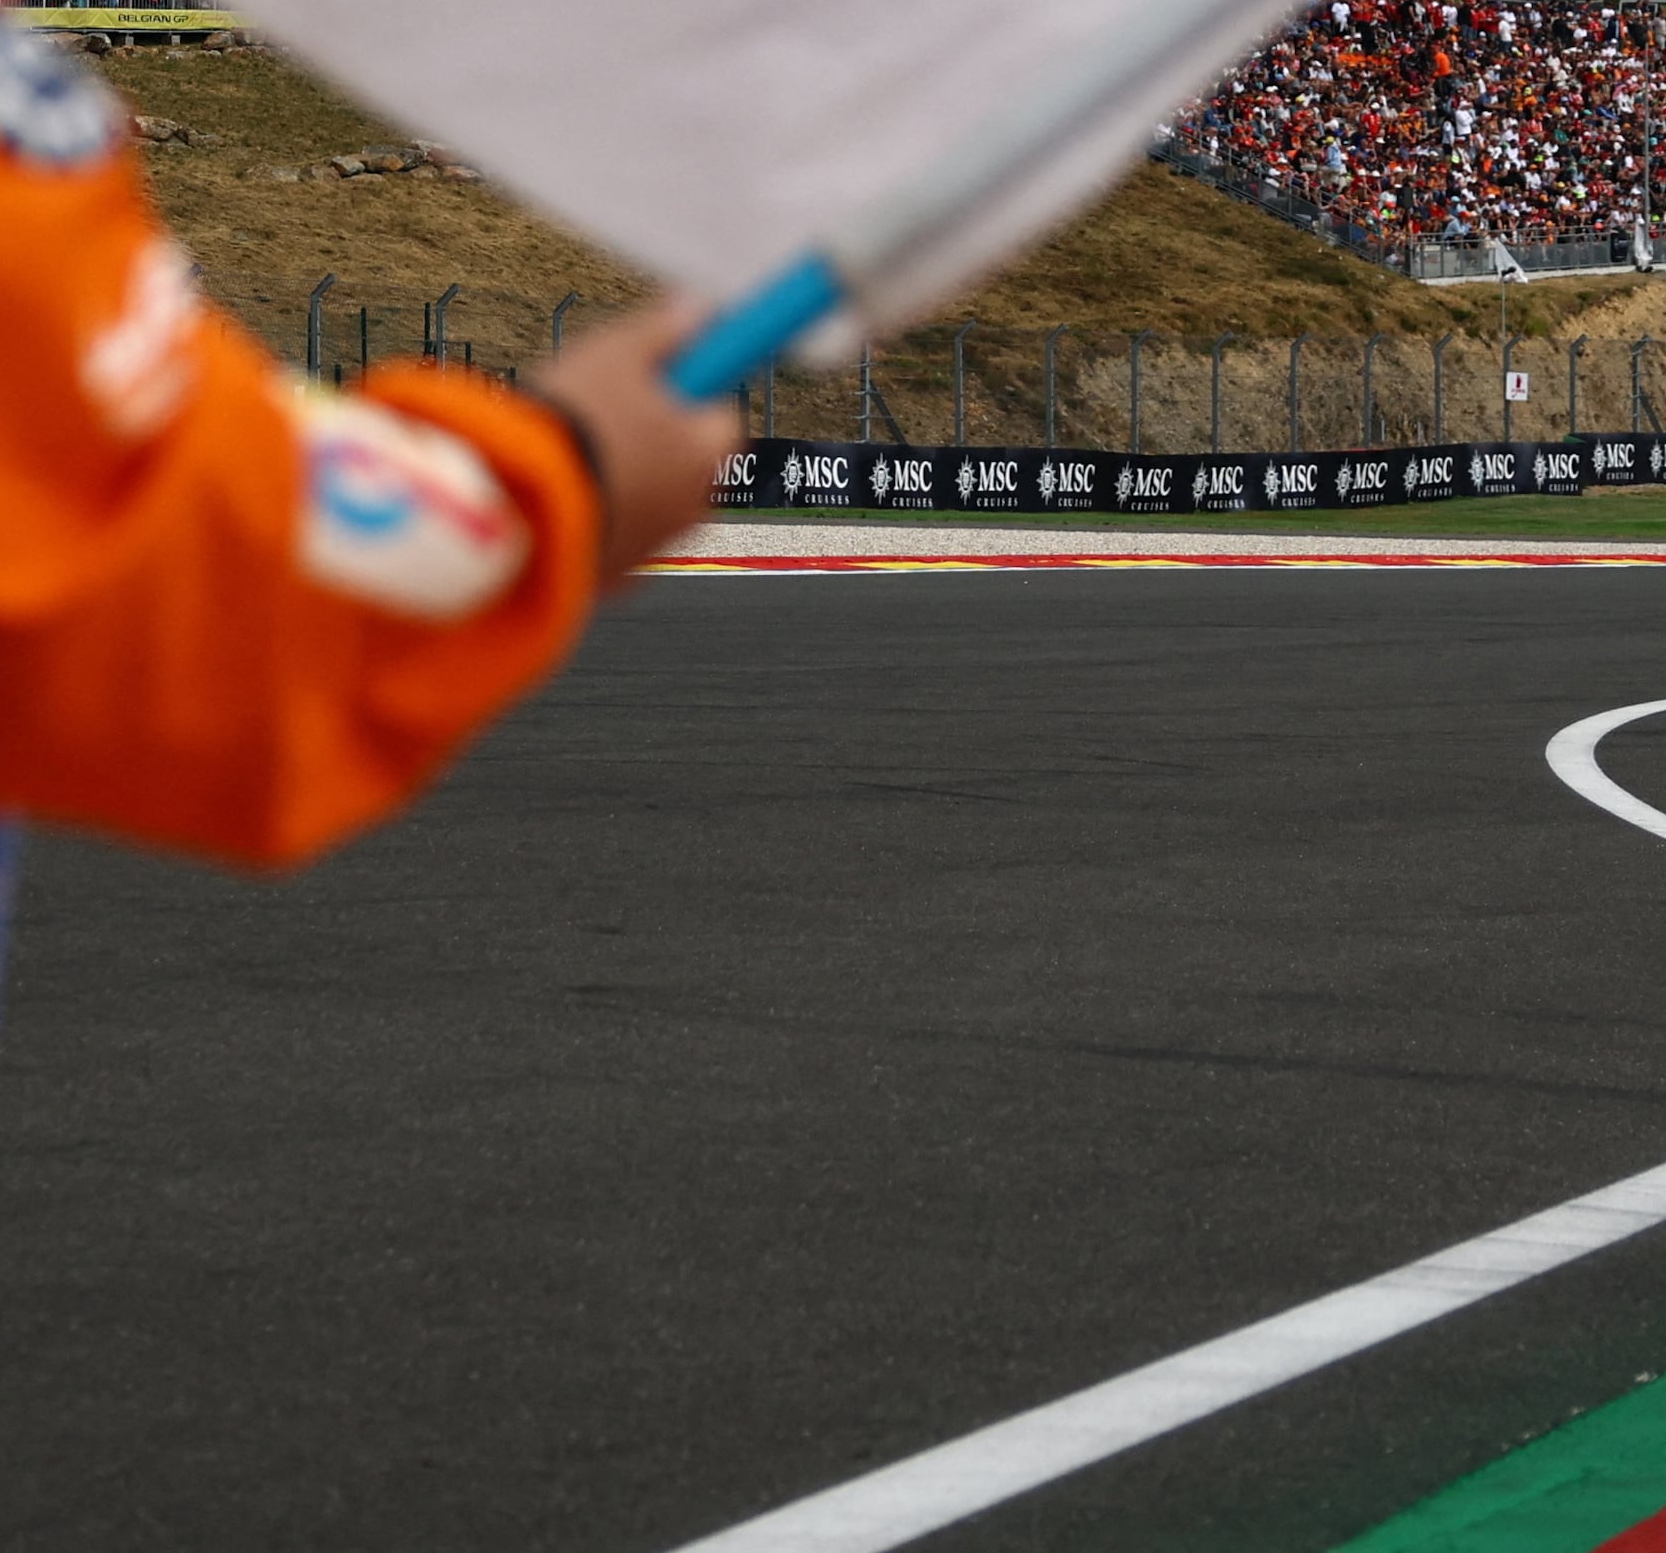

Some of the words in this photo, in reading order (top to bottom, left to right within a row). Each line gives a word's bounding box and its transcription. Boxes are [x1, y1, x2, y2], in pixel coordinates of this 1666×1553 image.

[118, 13, 171, 23] BELGIAN
[173, 14, 189, 23] GP
[1607, 444, 1635, 468] MSC
[712, 453, 757, 485] MSC
[804, 455, 849, 488] MSC
[893, 460, 933, 492] MSC
[1353, 462, 1388, 489] MSC
[1421, 457, 1453, 483] MSC
[1484, 454, 1515, 480] MSC
[1548, 454, 1580, 480] MSC
[978, 462, 1018, 491] MSC
[1058, 463, 1095, 493] MSC
[1133, 468, 1172, 496] MSC
[1209, 466, 1243, 495] MSC
[1281, 464, 1318, 492] MSC
[1418, 487, 1452, 497] CRUISES
[1484, 484, 1515, 493] CRUISES
[1548, 483, 1579, 492] CRUISES
[710, 492, 755, 503] CRUISES
[804, 493, 849, 505] CRUISES
[892, 497, 933, 507] CRUISES
[976, 497, 1018, 507] CRUISES
[1058, 497, 1092, 507] CRUISES
[1131, 501, 1169, 511] CRUISES
[1207, 499, 1245, 509] CRUISES
[1281, 497, 1315, 506] CRUISES
[1351, 493, 1385, 503] CRUISES
